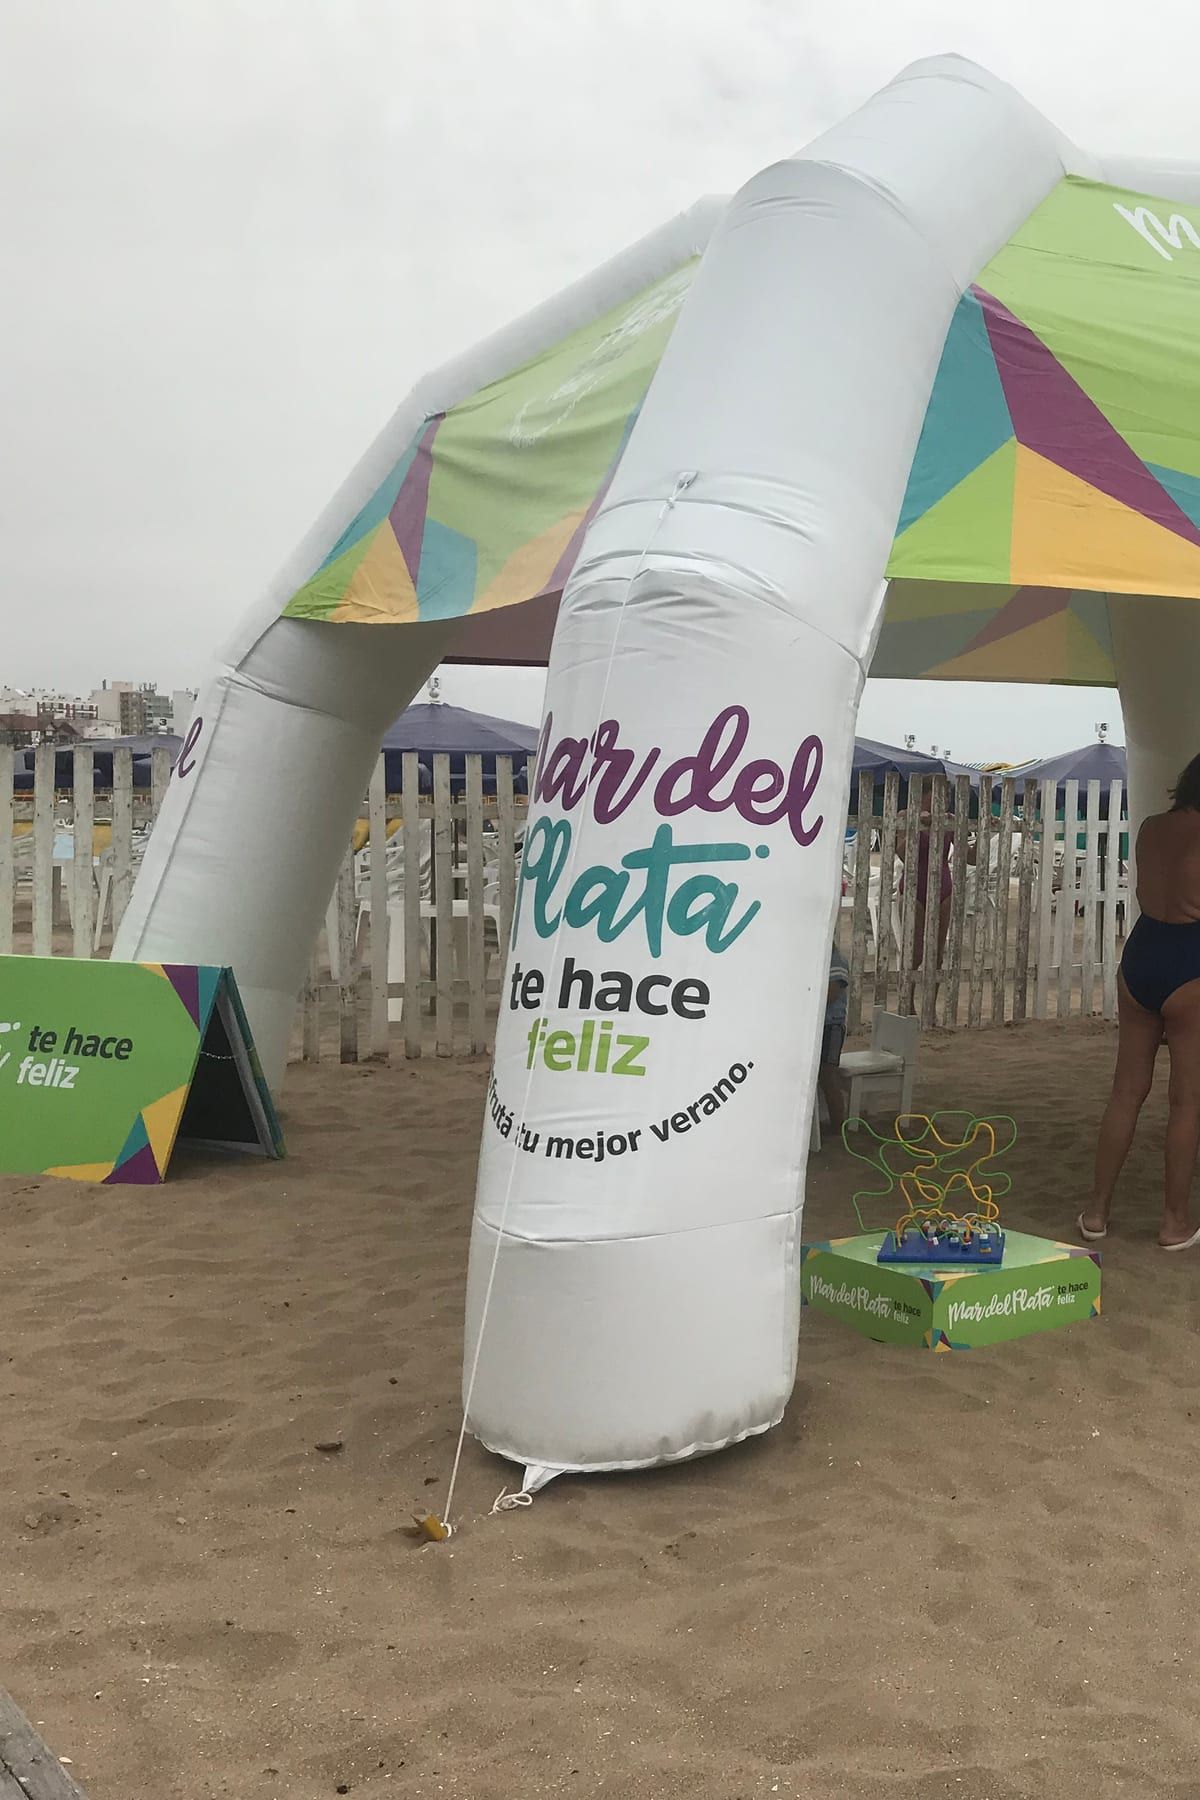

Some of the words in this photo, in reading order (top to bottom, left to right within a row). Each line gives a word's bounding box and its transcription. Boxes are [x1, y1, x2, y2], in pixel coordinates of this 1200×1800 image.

[654, 705, 824, 847] del
[512, 816, 770, 958] Plata
[510, 962, 545, 1011] te
[558, 957, 711, 1020] hace
[28, 1025, 57, 1053] te
[63, 1027, 133, 1060] hace
[527, 1017, 650, 1076] feliz
[17, 1056, 80, 1089] feliz
[515, 1122, 540, 1153] tu
[545, 1129, 642, 1162] mejor
[650, 1057, 755, 1143] verano.
[810, 1275, 838, 1303] Mar
[836, 1282, 858, 1309] del
[857, 1286, 892, 1319] Plata
[894, 1301, 902, 1312] te
[903, 1303, 921, 1317] hace
[948, 1300, 986, 1330] Mar
[984, 1294, 1013, 1319] del
[1011, 1286, 1055, 1315] Plata
[1057, 1284, 1066, 1295] te
[1068, 1281, 1089, 1294] hace
[1057, 1293, 1076, 1305] feliz
[893, 1310, 910, 1325] feliz
